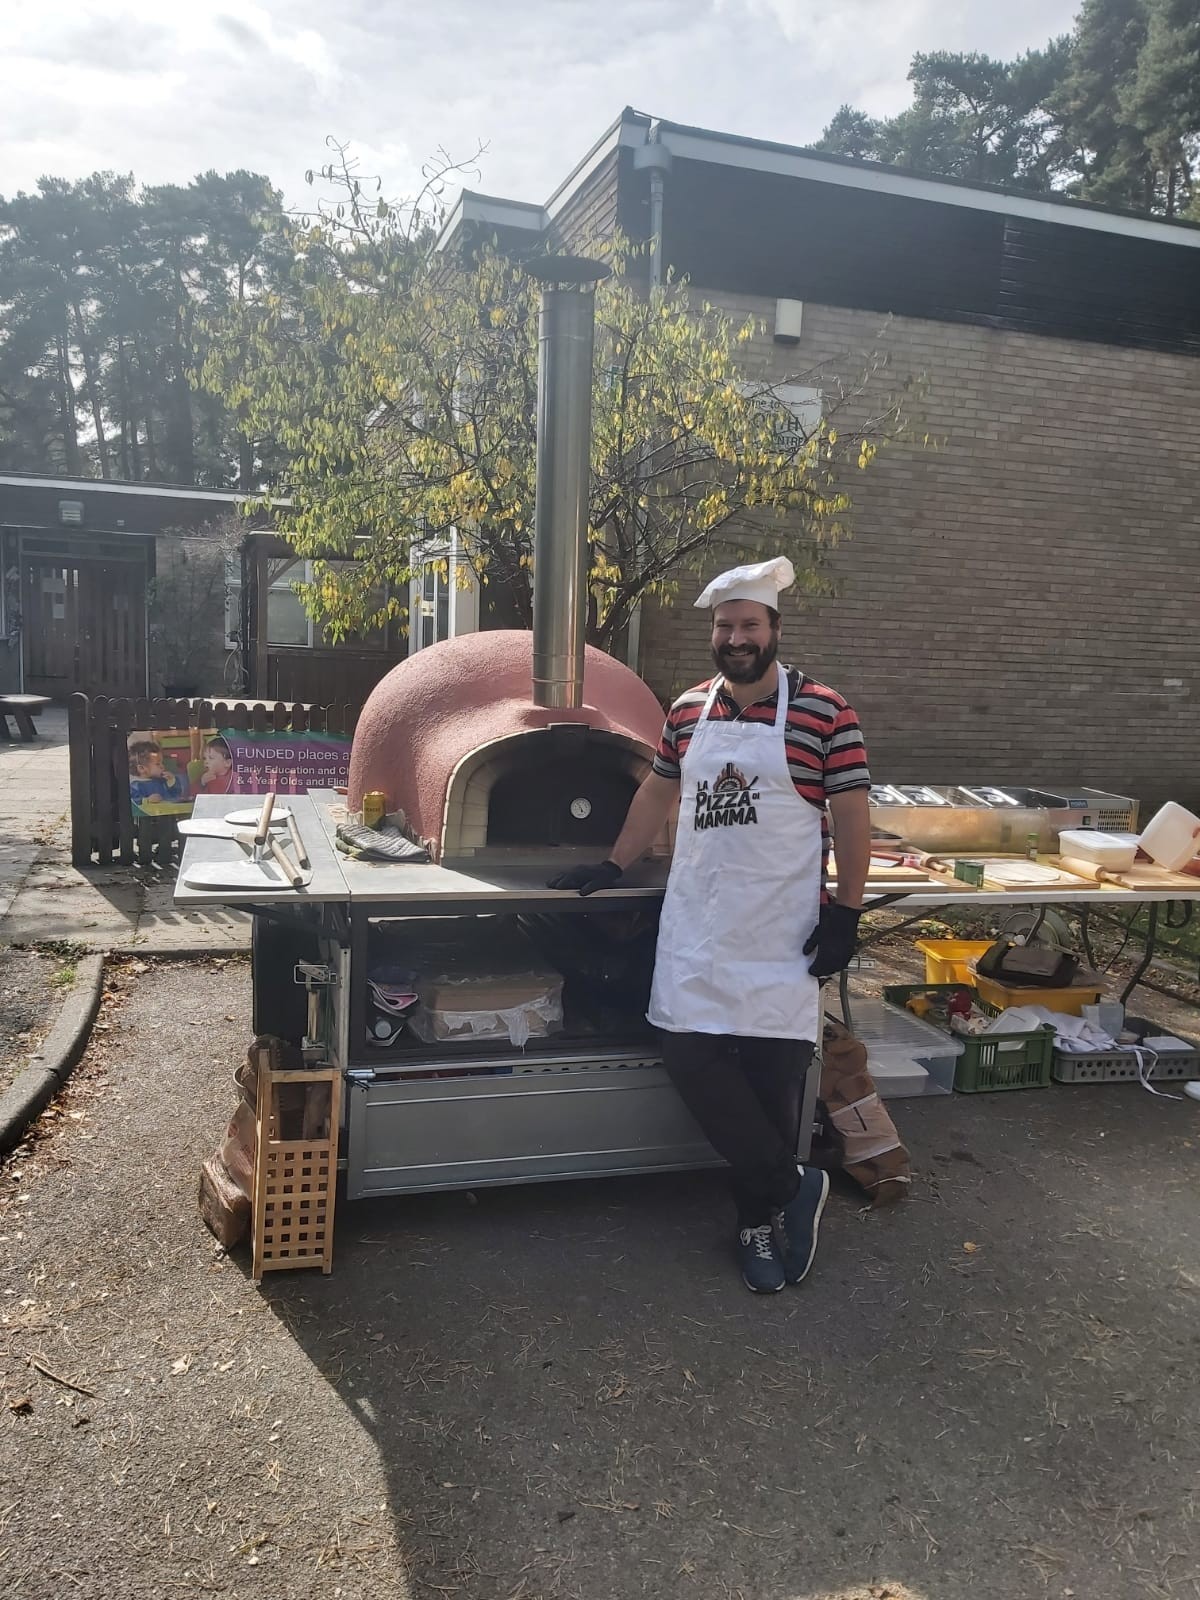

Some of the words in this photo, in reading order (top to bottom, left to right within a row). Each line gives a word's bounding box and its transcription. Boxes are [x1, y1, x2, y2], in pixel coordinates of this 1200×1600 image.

[237, 747, 295, 760] FUNDED
[298, 748, 339, 762] places
[236, 764, 262, 775] Early
[264, 765, 315, 775] Education
[317, 767, 336, 775] and
[237, 776, 245, 785] &
[246, 776, 253, 785] 4
[254, 776, 278, 785] Year
[280, 776, 304, 786] Olds
[305, 778, 325, 786] and
[697, 780, 709, 792] LA
[696, 791, 751, 814] PIZZA
[694, 806, 758, 831] MAMMA
